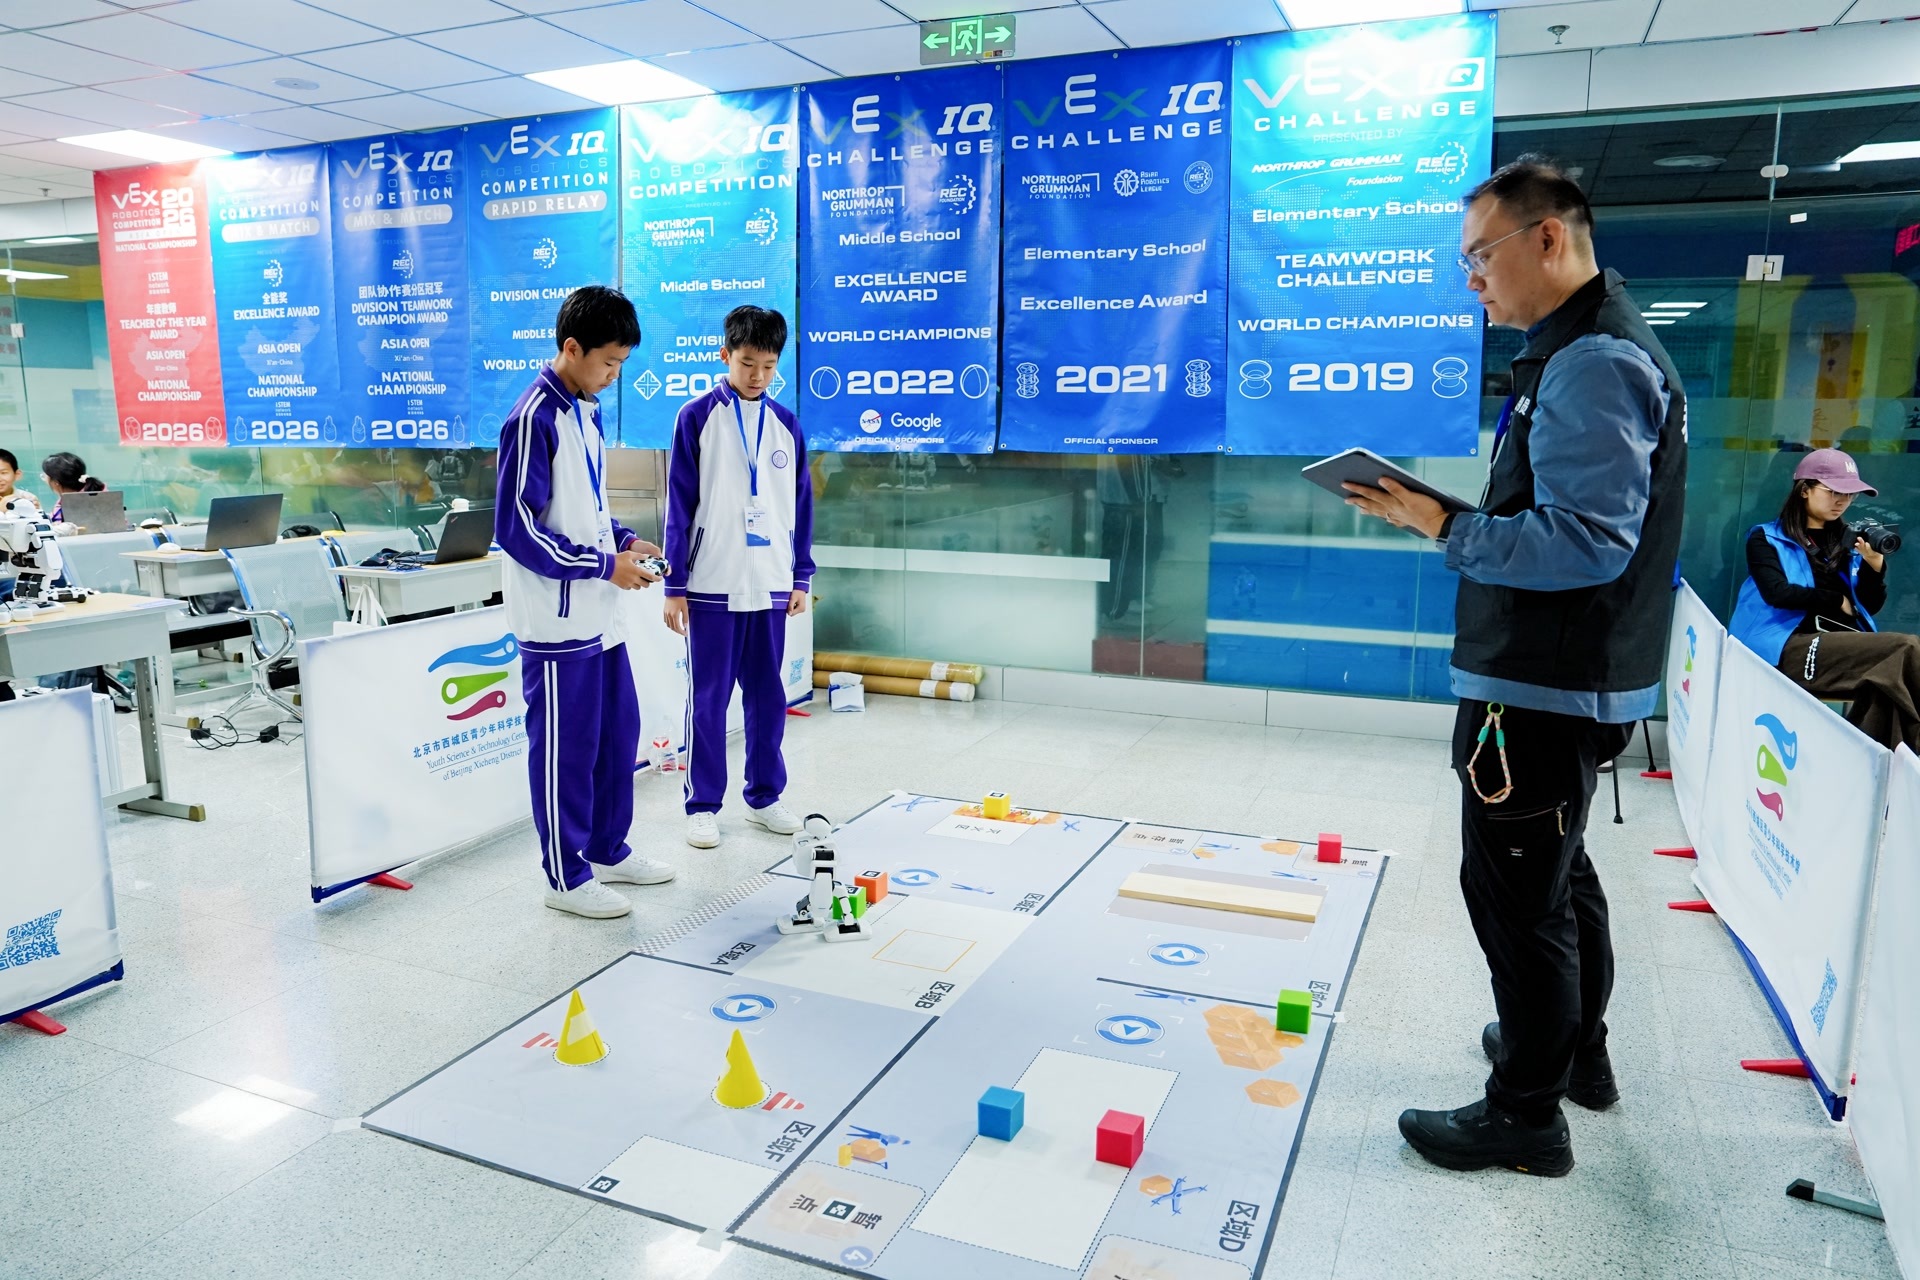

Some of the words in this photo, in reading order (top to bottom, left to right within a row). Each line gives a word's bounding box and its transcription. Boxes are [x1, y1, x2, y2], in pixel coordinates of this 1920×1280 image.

[1243, 51, 1400, 109] VEX
[1012, 73, 1149, 127] VEX
[1160, 80, 1224, 117] IQ
[809, 95, 929, 145] VEX
[936, 103, 993, 135] IQ
[1254, 100, 1476, 132] CHALLENGE
[743, 123, 792, 154] IQ
[1011, 118, 1223, 150] CHALLENGE
[1313, 129, 1383, 144] PRESENTED
[1387, 128, 1404, 139] BY
[480, 124, 562, 164] VEX
[566, 130, 606, 157] IQ
[341, 141, 413, 179] VEX
[417, 149, 453, 172] IQ
[807, 139, 994, 168] CHALLENGE
[481, 157, 608, 179] ROBOTICS
[629, 158, 793, 181] ROBOTICS
[1251, 159, 1326, 174] NORTHROP
[1330, 153, 1404, 168] GRUMMAN
[1416, 156, 1459, 168] REC
[481, 171, 608, 196] COMPETITION
[629, 174, 793, 199] COMPETITION
[1022, 174, 1083, 185] NORTHROP
[1347, 174, 1404, 187] Foundation
[111, 182, 159, 209] VEX
[822, 187, 885, 201] NORTHROP
[940, 187, 967, 198] REC
[1030, 183, 1091, 194] GRUMMAN
[342, 187, 453, 208] COMPETITION
[492, 200, 537, 217] RAPID
[546, 194, 600, 212] RELAY
[830, 197, 894, 211] GRUMMAN
[112, 208, 160, 219] ROBOTICS
[220, 200, 320, 221] COMPETITION
[353, 214, 376, 228] MIX
[383, 213, 393, 225] &
[400, 209, 442, 223] MATCH
[830, 209, 894, 218] FOUNDATION
[1253, 204, 1380, 223] Elementary
[1385, 199, 1464, 216] School
[113, 217, 161, 229] COMPETITION
[644, 218, 696, 231] NORTHROP
[746, 220, 770, 229] REC
[652, 228, 704, 241] GRUMMAN
[652, 238, 705, 247] FOUNDATION
[839, 232, 896, 246] Middle
[900, 228, 961, 243] School
[115, 243, 147, 252] NATIONAL
[148, 239, 197, 250] CHAMPIONSHIP
[533, 247, 551, 256] REC
[1024, 247, 1138, 261] Elementary
[1143, 239, 1206, 257] School
[393, 259, 410, 267] REC
[1276, 248, 1436, 269] TEAMWORK
[660, 281, 708, 293] Middle
[711, 277, 765, 291] School
[834, 270, 967, 288] EXCELLENCE
[1277, 268, 1434, 288] CHALLENGE
[262, 291, 288, 305] 全能奖
[358, 282, 444, 299] 团队协作赛分区冠军
[490, 289, 540, 302] DIVISION
[542, 286, 582, 299] CHAM
[860, 288, 938, 304] AWARD
[351, 301, 398, 314] DIVISION
[401, 298, 453, 311] TEAMWORK
[1021, 296, 1135, 310] Excellence
[1138, 290, 1208, 309] Award
[233, 308, 285, 320] EXCELLENCE
[286, 306, 320, 317] AWARD
[357, 313, 416, 326] CHAMPION
[417, 312, 448, 324] AWARD
[120, 318, 155, 329] TEACHER
[156, 318, 168, 328] OF
[168, 317, 184, 327] THE
[185, 316, 207, 327] YEAR
[1237, 317, 1321, 332] WORLD
[1326, 314, 1474, 330] CHAMPIONS
[149, 329, 178, 340] AWARD
[512, 329, 546, 340] MIDDLE
[676, 335, 725, 347] DIVISI
[808, 330, 875, 343] WORLD
[878, 327, 992, 341] CHAMPIONS
[257, 344, 276, 354] ASIA
[277, 343, 301, 353] OPEN
[381, 339, 408, 349] ASIA
[410, 338, 430, 348] OPEN
[146, 350, 164, 360] ASIA
[165, 349, 186, 359] OPEN
[483, 359, 526, 371] WORLD
[528, 358, 546, 370] CH
[148, 379, 190, 390] NATIONAL
[258, 374, 304, 385] NATIONAL
[381, 371, 434, 382] NATIONAL
[847, 369, 954, 395] 2022
[1056, 364, 1167, 394] 2021
[1288, 362, 1414, 392] 2019
[137, 391, 202, 402] CHAMPIONSHIP
[247, 386, 317, 397] CHAMPIONSHIP
[367, 384, 446, 396] CHAMPIONSHIP
[251, 420, 319, 440] 2026
[371, 419, 449, 441] 2026
[890, 412, 942, 432] Google
[142, 423, 204, 442] 2026
[854, 436, 894, 444] OFFICIAL
[895, 436, 945, 444] SPONSORS
[426, 757, 446, 770] Youth
[446, 749, 470, 763] Science
[471, 746, 477, 755] &
[477, 737, 511, 753] Technology
[443, 771, 450, 781] of
[450, 763, 473, 779] Beijing
[474, 755, 500, 771] Xicheng
[500, 747, 522, 761] District
[710, 941, 757, 965] 区域A
[914, 981, 956, 1009] 区域B
[764, 1120, 816, 1163] 区域F
[1218, 1199, 1260, 1253] 区域D
